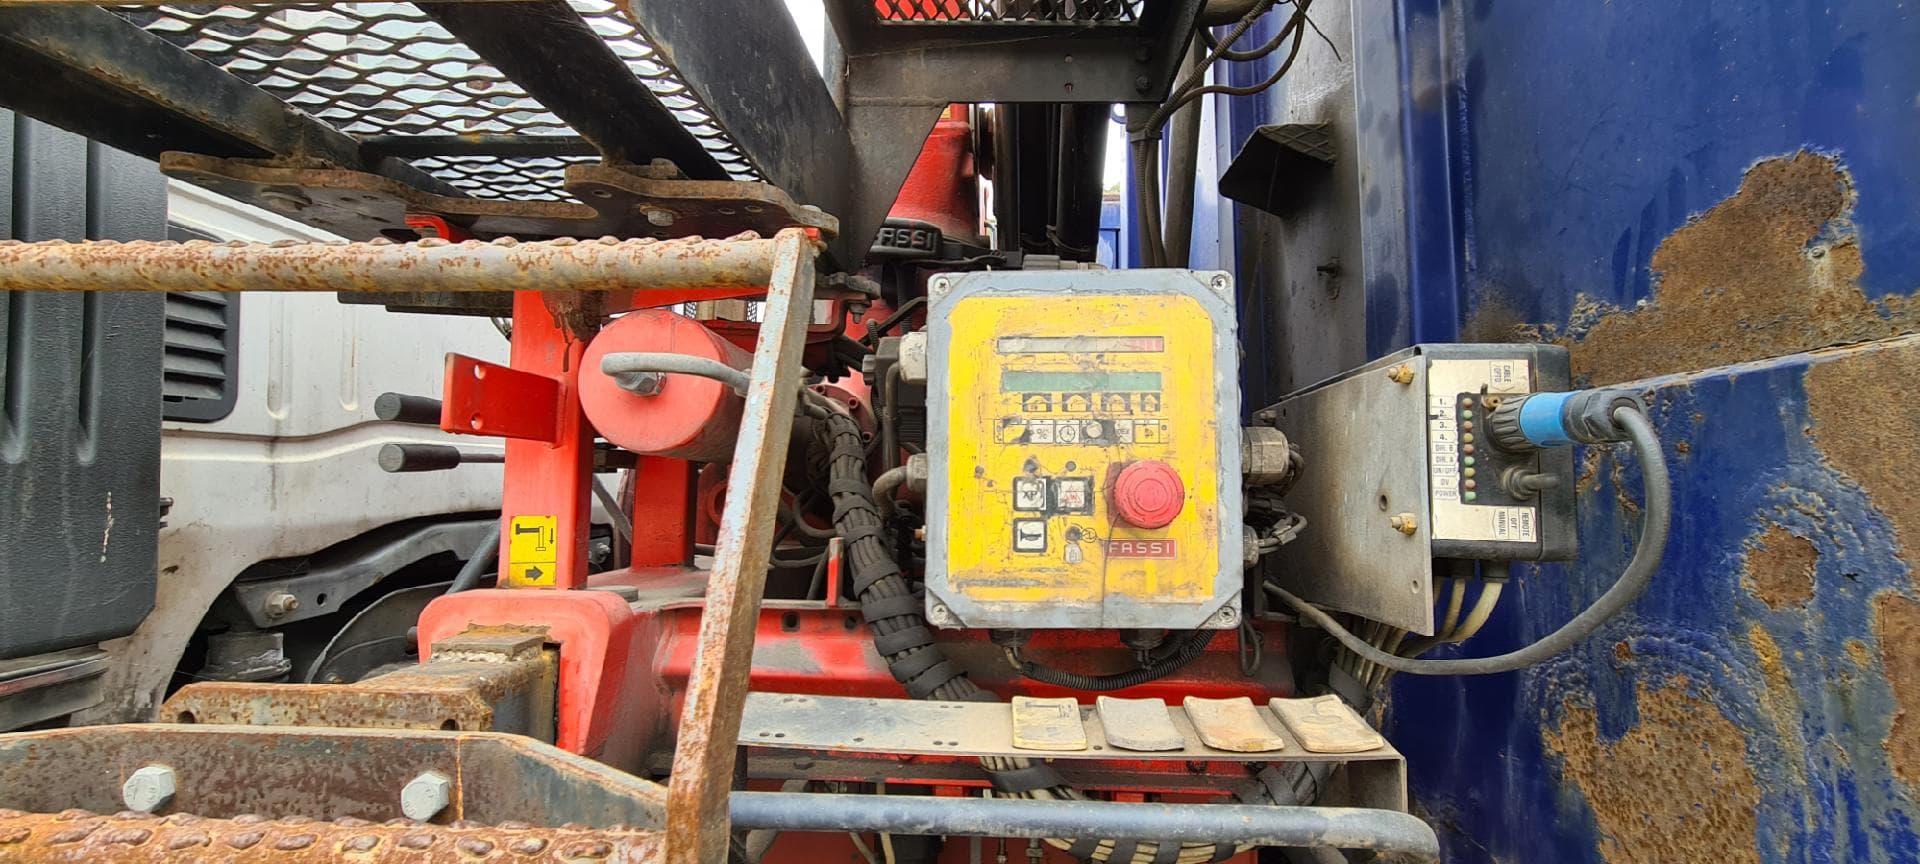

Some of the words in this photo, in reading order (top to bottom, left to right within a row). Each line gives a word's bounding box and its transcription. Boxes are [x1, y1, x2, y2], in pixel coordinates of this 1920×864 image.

[877, 227, 931, 248] ASSI
[1439, 398, 1447, 406] 1.
[1439, 421, 1448, 429] 3.
[1023, 491, 1038, 500] XP
[1522, 512, 1530, 537] REMOTE
[1109, 542, 1170, 553] FASSI
